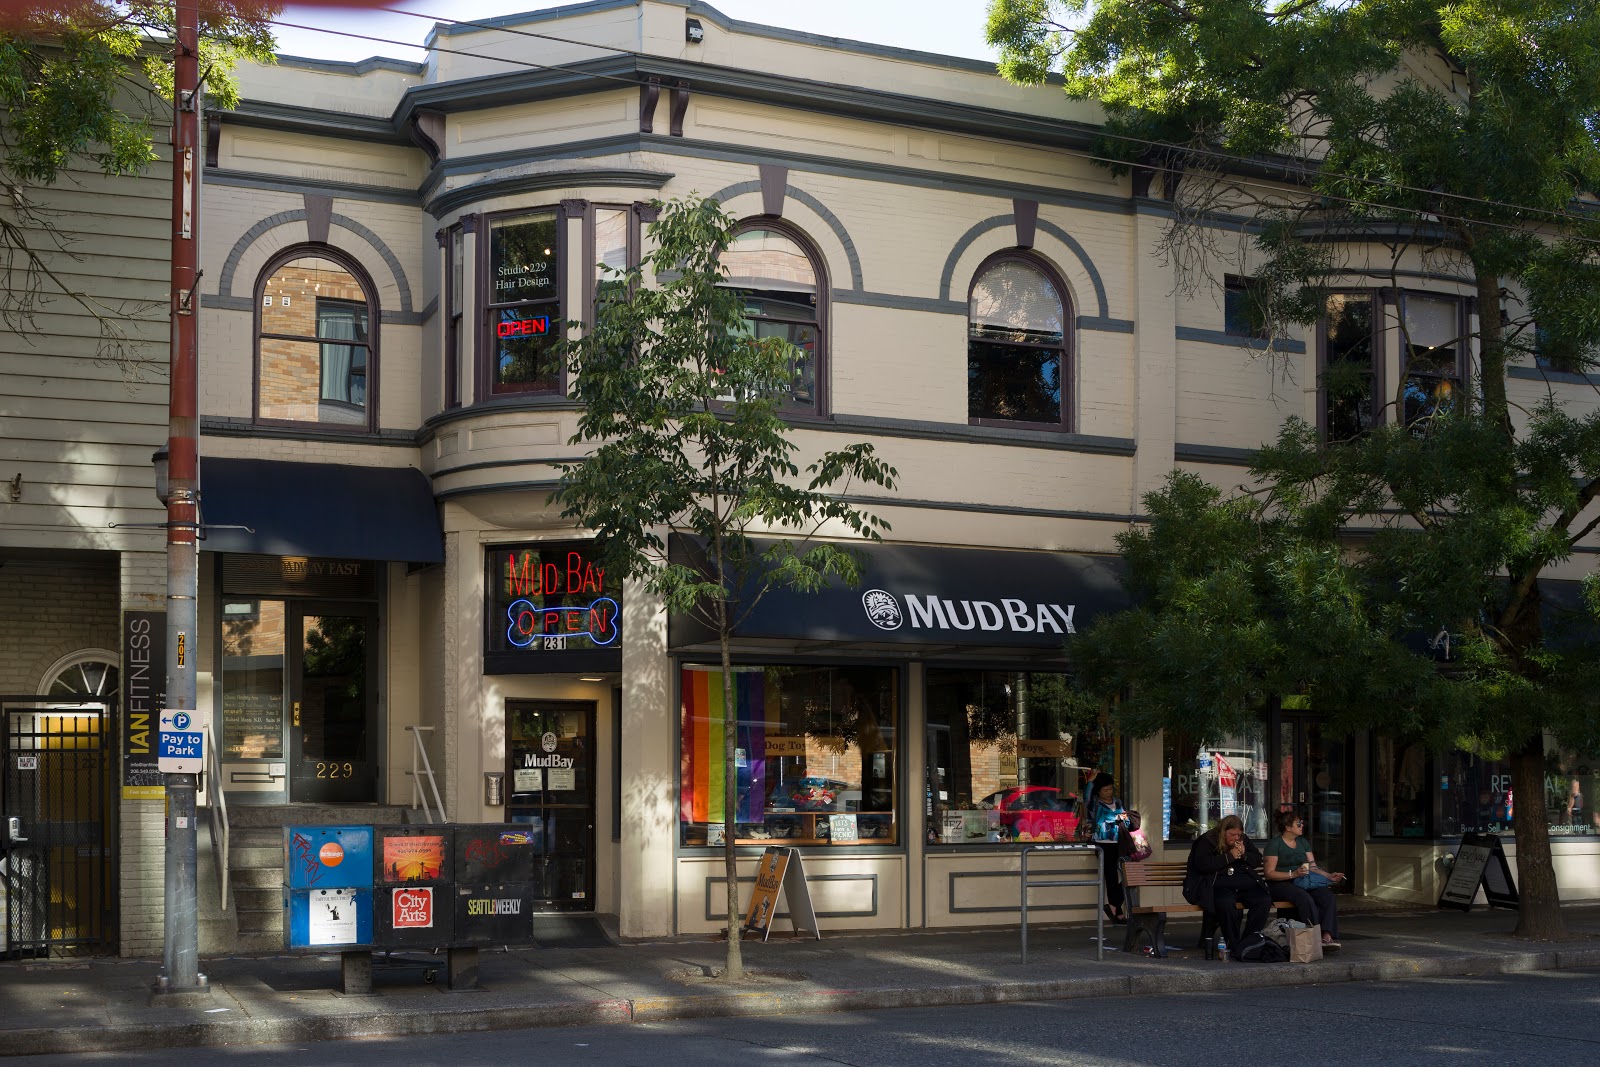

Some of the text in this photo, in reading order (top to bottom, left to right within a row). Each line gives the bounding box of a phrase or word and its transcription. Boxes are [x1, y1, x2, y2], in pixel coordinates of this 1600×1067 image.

[498, 262, 547, 276] Studio 229
[496, 277, 549, 290] Hair Design
[497, 318, 545, 337] OPEN
[329, 562, 361, 576] EAST
[509, 551, 605, 596] MUD BAY
[517, 608, 607, 635] OPEN
[545, 637, 565, 650] 231
[162, 734, 201, 745] Pay to
[765, 741, 785, 752] Dog
[167, 745, 195, 756] Park
[1020, 742, 1044, 753] Toys
[524, 753, 575, 770] MudBay
[316, 762, 353, 779] 229
[1460, 823, 1475, 833] Buy
[397, 893, 427, 911] City
[397, 907, 427, 922] Arts
